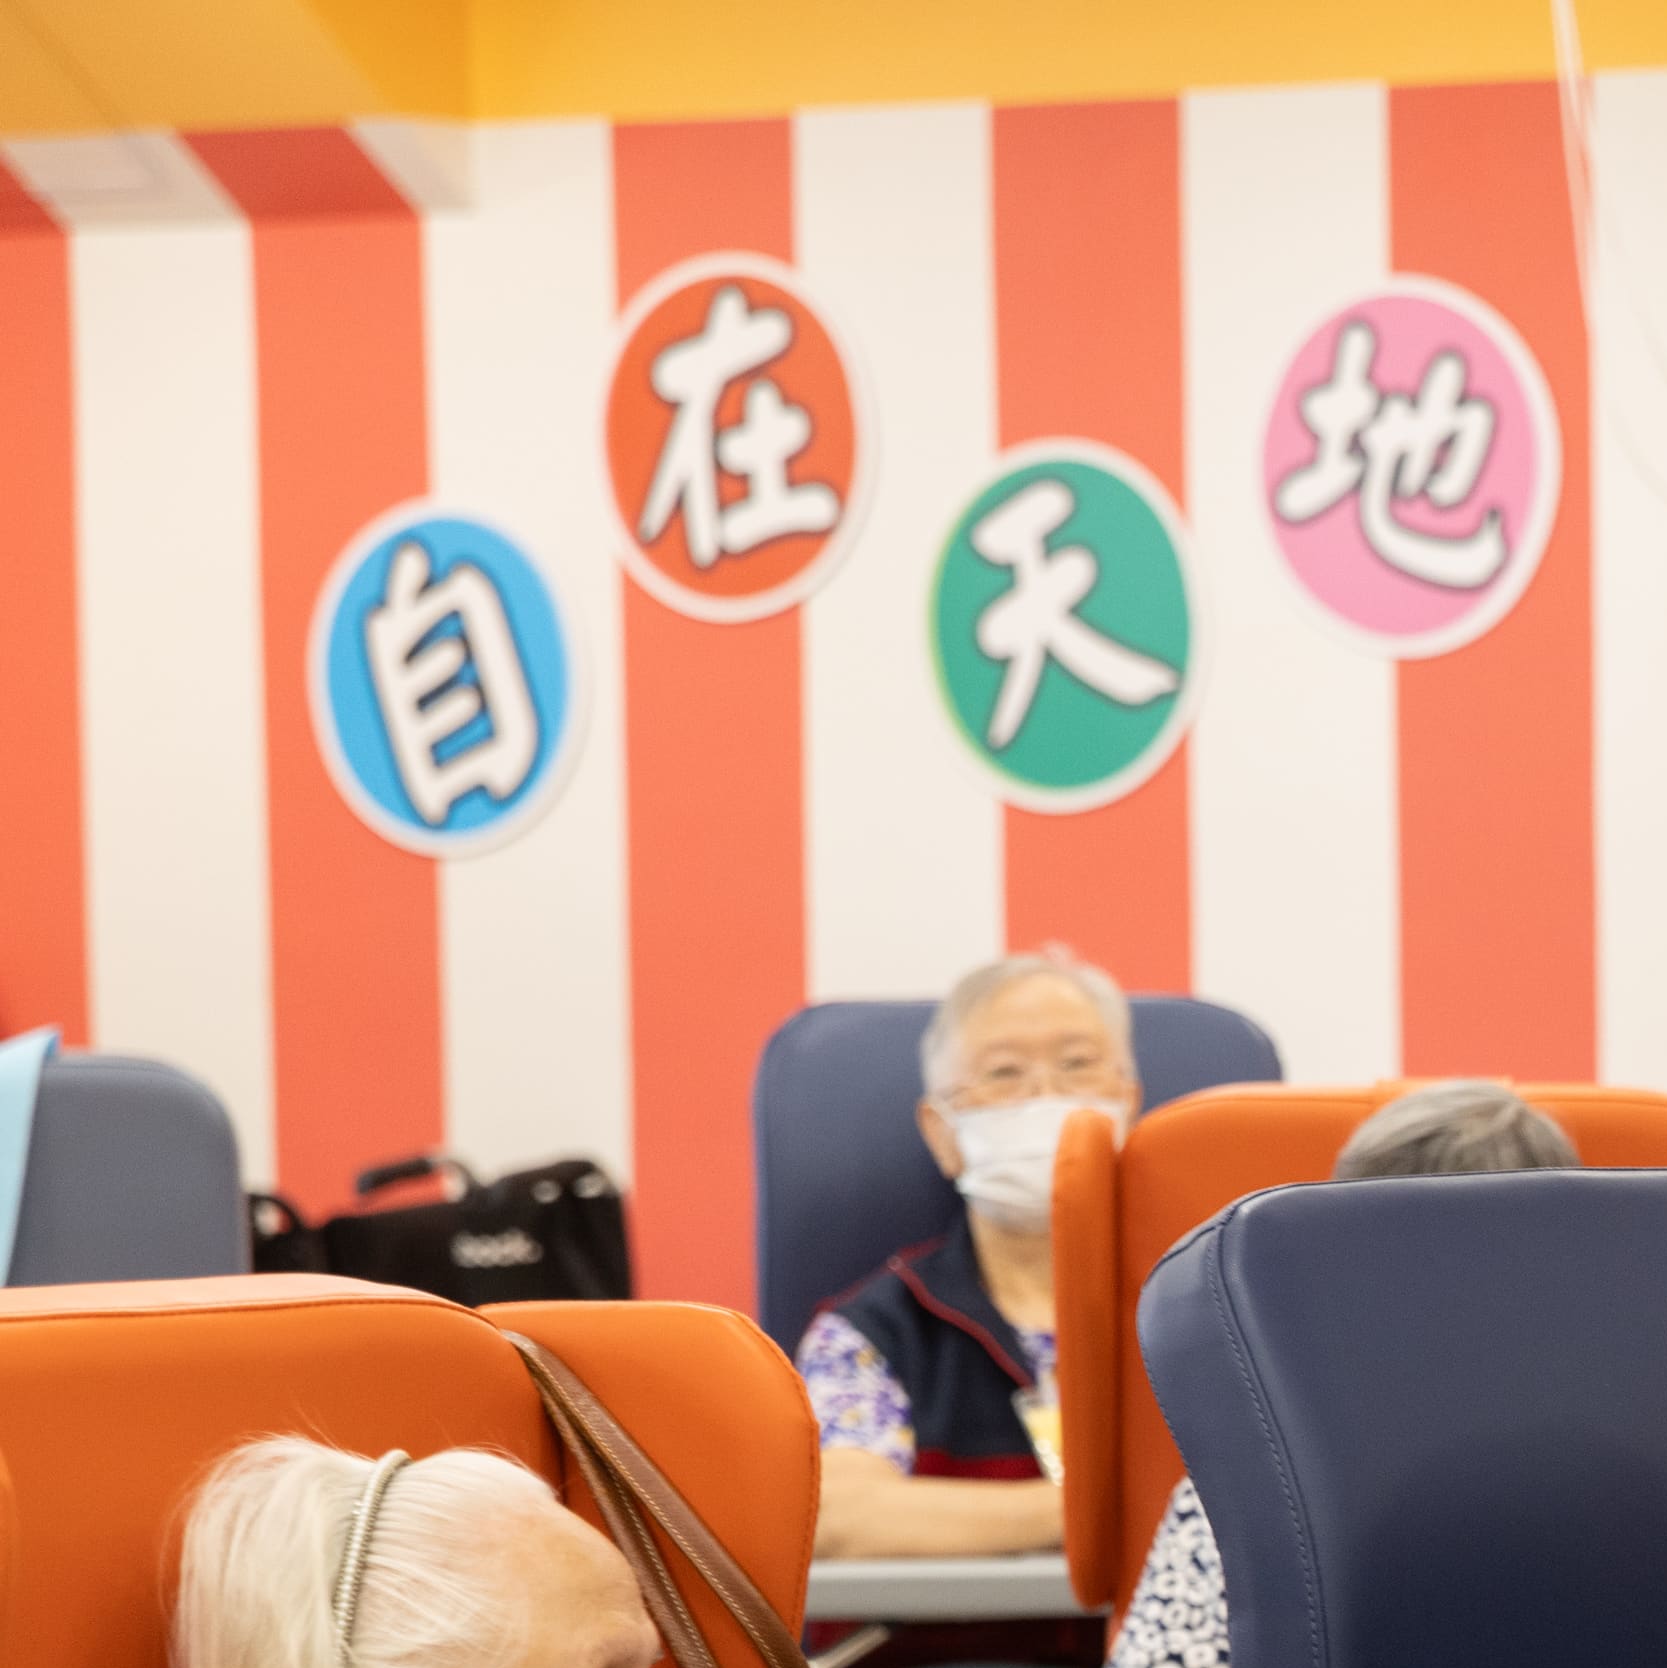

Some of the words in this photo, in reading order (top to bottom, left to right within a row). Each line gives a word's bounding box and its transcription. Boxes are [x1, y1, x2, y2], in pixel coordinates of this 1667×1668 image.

[365, 539, 541, 829] 自
[639, 282, 843, 570] 在
[969, 478, 1183, 751] 天
[1272, 314, 1508, 590] 地
